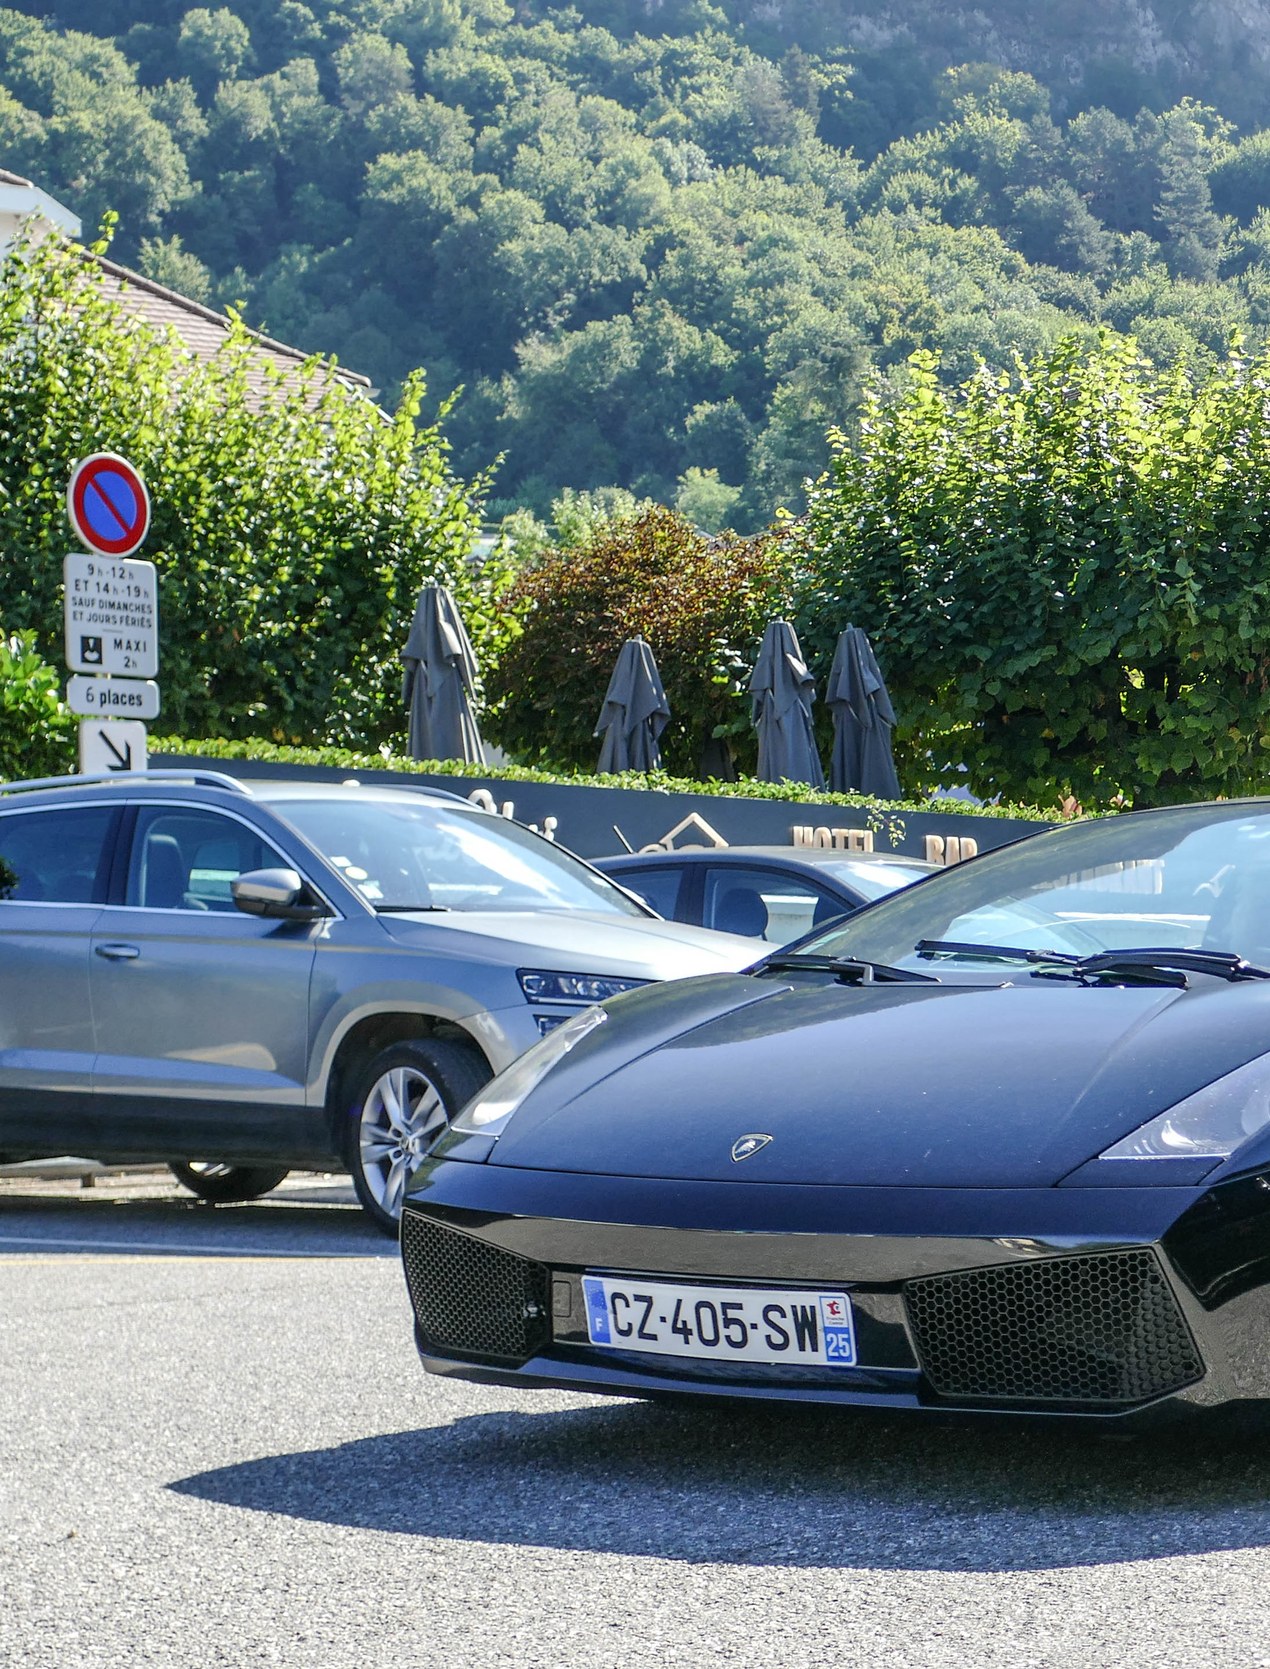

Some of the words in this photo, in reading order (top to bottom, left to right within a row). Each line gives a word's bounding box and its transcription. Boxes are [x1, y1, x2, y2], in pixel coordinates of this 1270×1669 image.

[74, 579, 88, 592] ET
[71, 596, 96, 608] SAUF
[98, 599, 153, 615] DIMANCHES
[72, 611, 84, 621] ET
[87, 612, 117, 625] JOURS
[113, 638, 147, 653] MAXI
[86, 686, 95, 703] 6
[100, 688, 143, 708] places
[596, 1318, 603, 1332] F
[610, 1292, 819, 1353] CZ-405-SW
[826, 1333, 850, 1357] 25
